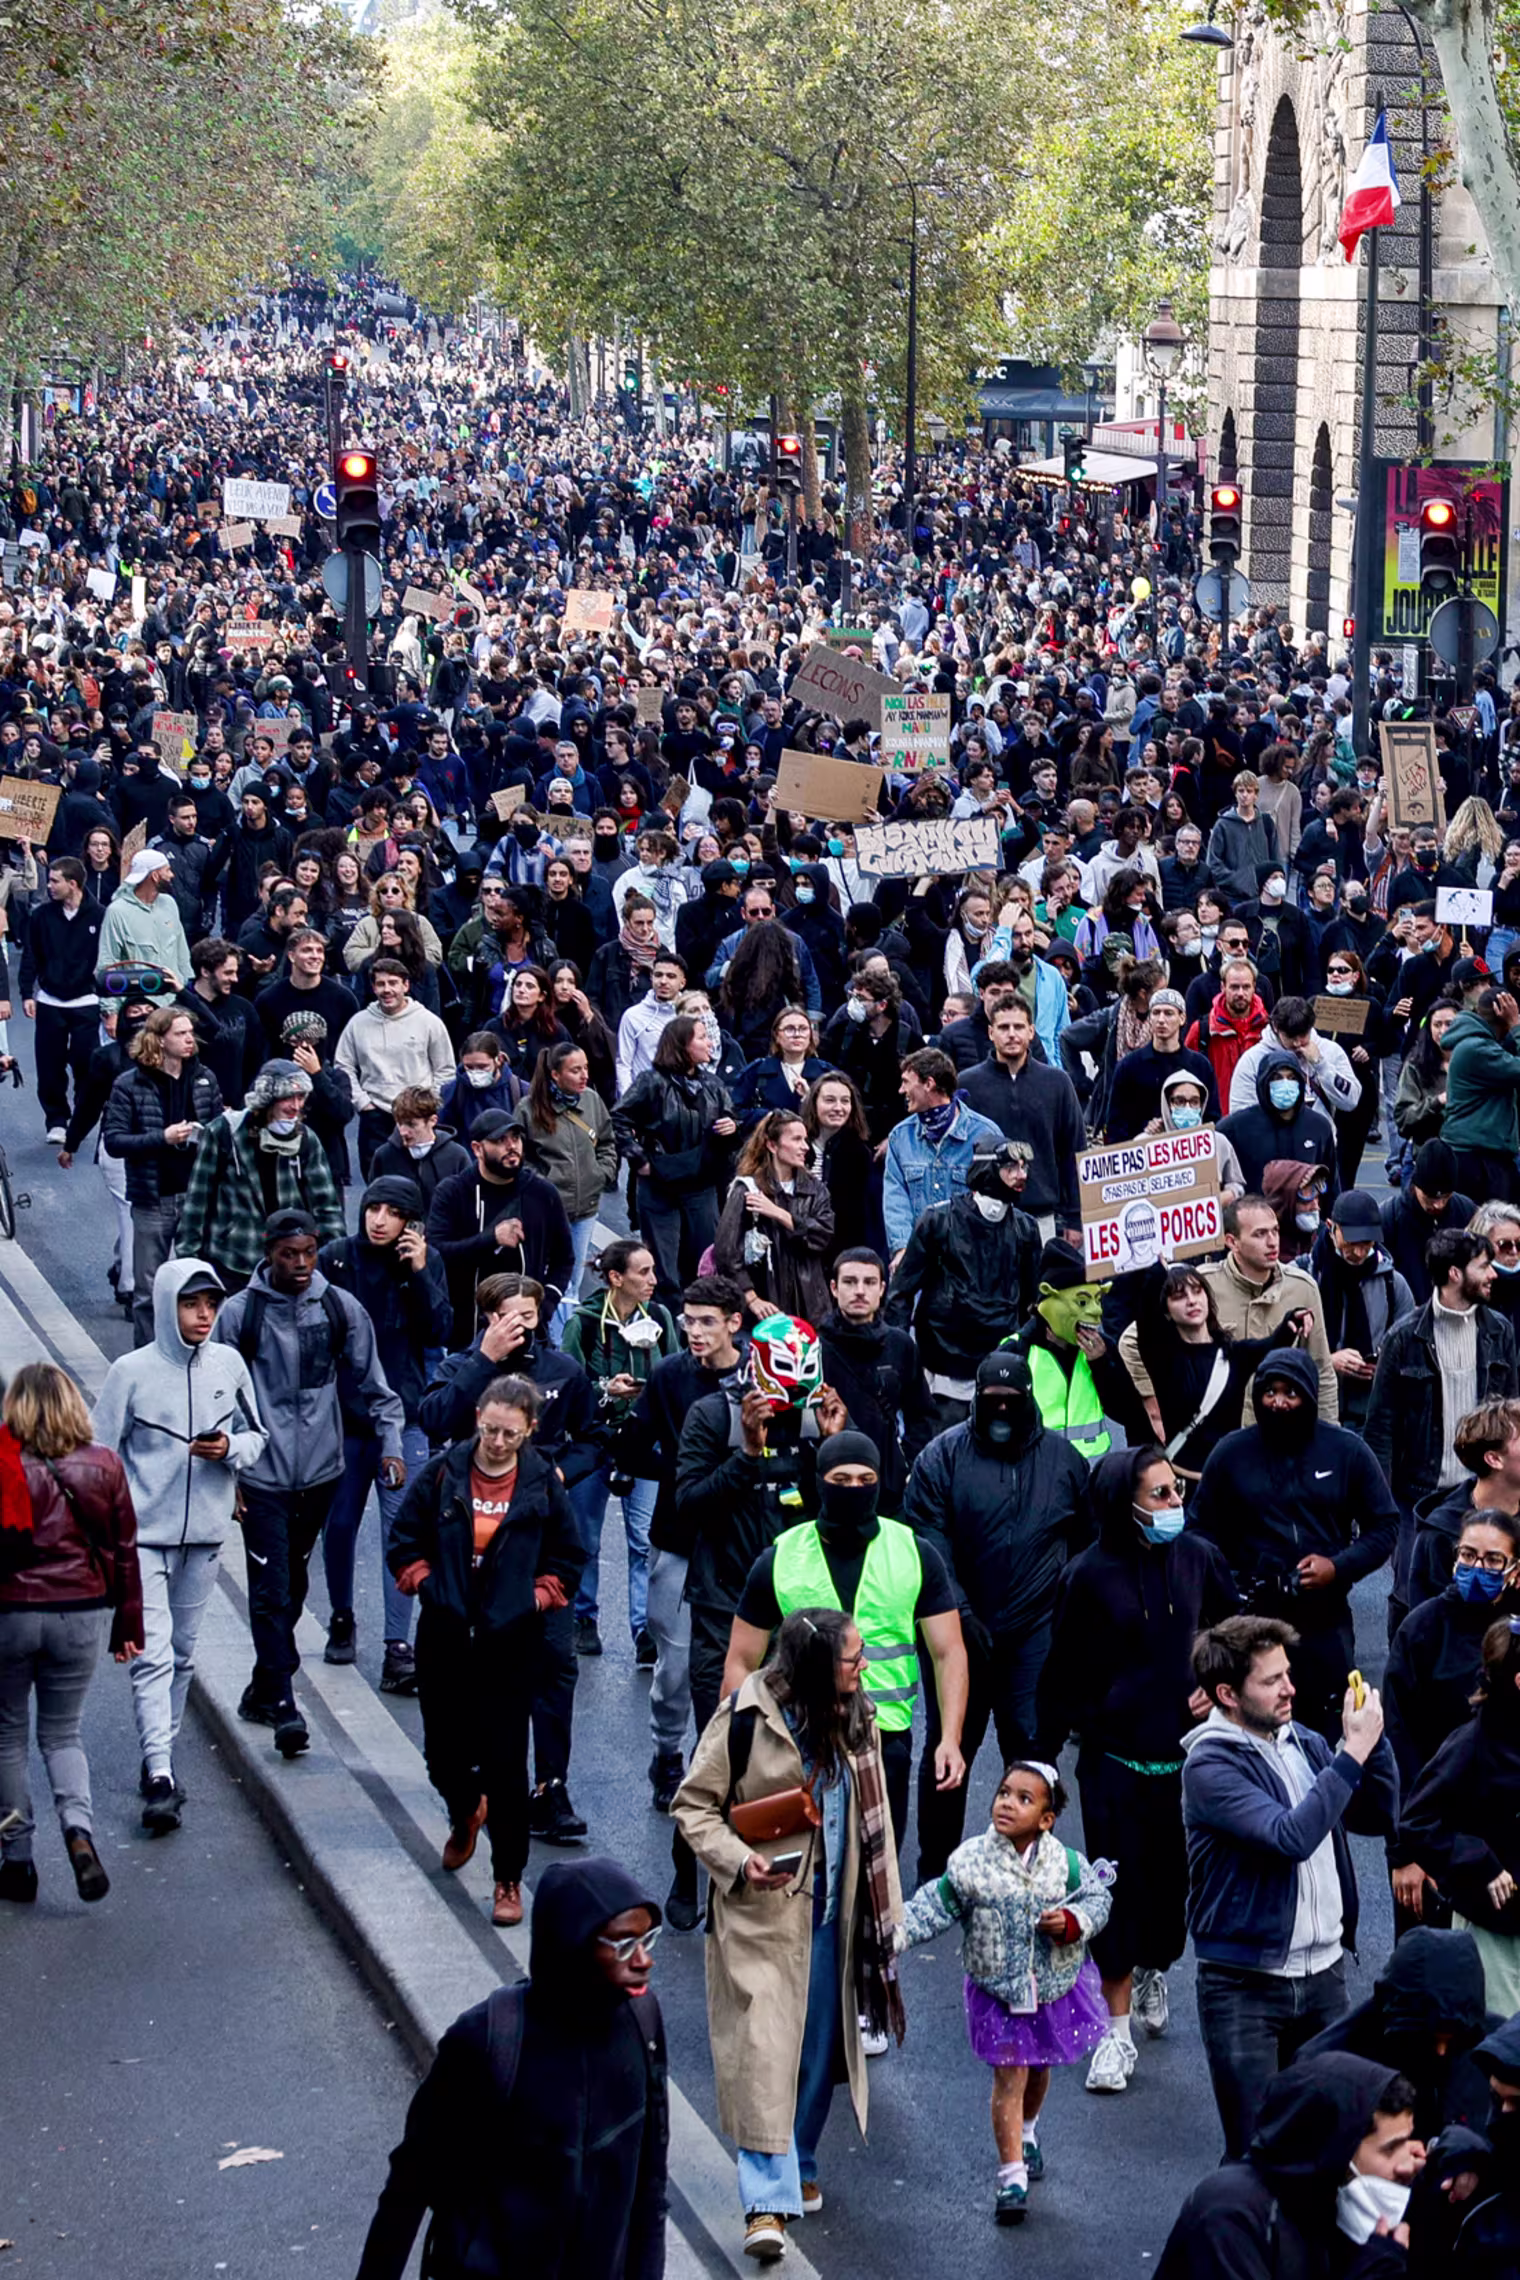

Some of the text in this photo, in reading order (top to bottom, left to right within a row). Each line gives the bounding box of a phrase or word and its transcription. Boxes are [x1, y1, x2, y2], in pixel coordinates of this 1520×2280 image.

[1082, 1133, 1212, 1182] J'AIME PAS LES KEUFS
[1089, 1221, 1121, 1262] LES
[1160, 1200, 1218, 1246] PORCS
